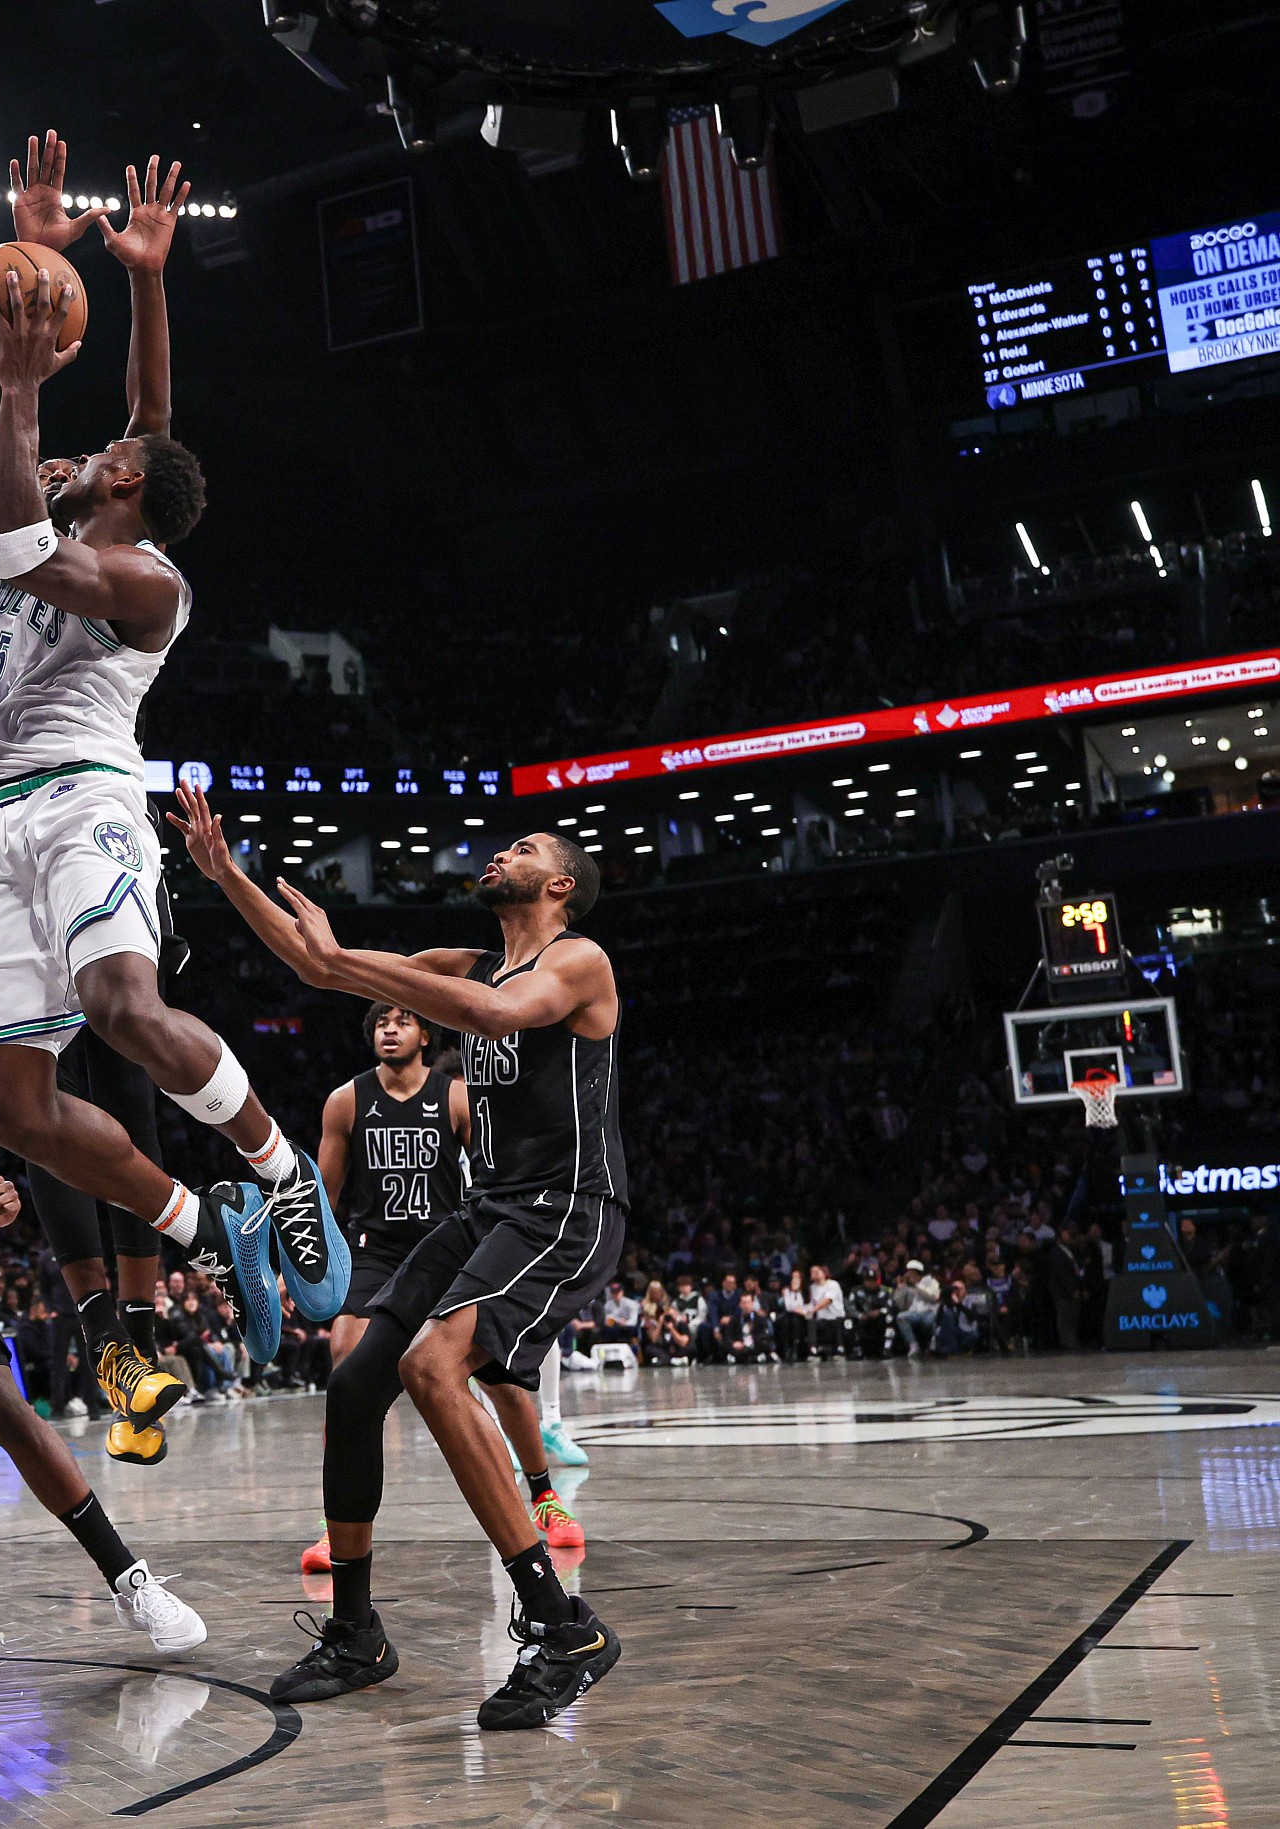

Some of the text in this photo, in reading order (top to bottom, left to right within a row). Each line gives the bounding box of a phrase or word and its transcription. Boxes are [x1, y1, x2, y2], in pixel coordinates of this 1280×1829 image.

[1193, 233, 1280, 276] ON DEMA
[974, 259, 1146, 308] 3 McDaniels 0 0 0
[992, 302, 1046, 324] Edwards
[1096, 288, 1106, 300] 0
[1120, 283, 1128, 295] 1
[1140, 279, 1149, 291] 2
[1170, 284, 1213, 306] HOUSE
[1218, 274, 1258, 296] CALLS
[996, 313, 1089, 342] Alexander-Walker
[1099, 307, 1109, 319] 0
[1122, 302, 1132, 314] 0
[1145, 298, 1153, 309] 1
[1186, 287, 1280, 320] AT HOME URGE
[983, 316, 1156, 363] 11 Reid 0 0 1
[984, 335, 1159, 383] 27 Gobert 2 1 1
[1021, 372, 1085, 400] MINNESOTA
[37, 535, 50, 552] 5
[1100, 661, 1277, 698] Global Leading Hot Pot Brand
[1062, 901, 1108, 927] 2:58
[1083, 922, 1107, 954] 7
[1070, 959, 1118, 974] TISSOT
[365, 1128, 440, 1169] NETS
[476, 1096, 495, 1170] 1
[382, 1173, 431, 1221] 24
[1127, 1261, 1173, 1272] BARCLAYS
[1119, 1312, 1200, 1331] BARCLAYS
